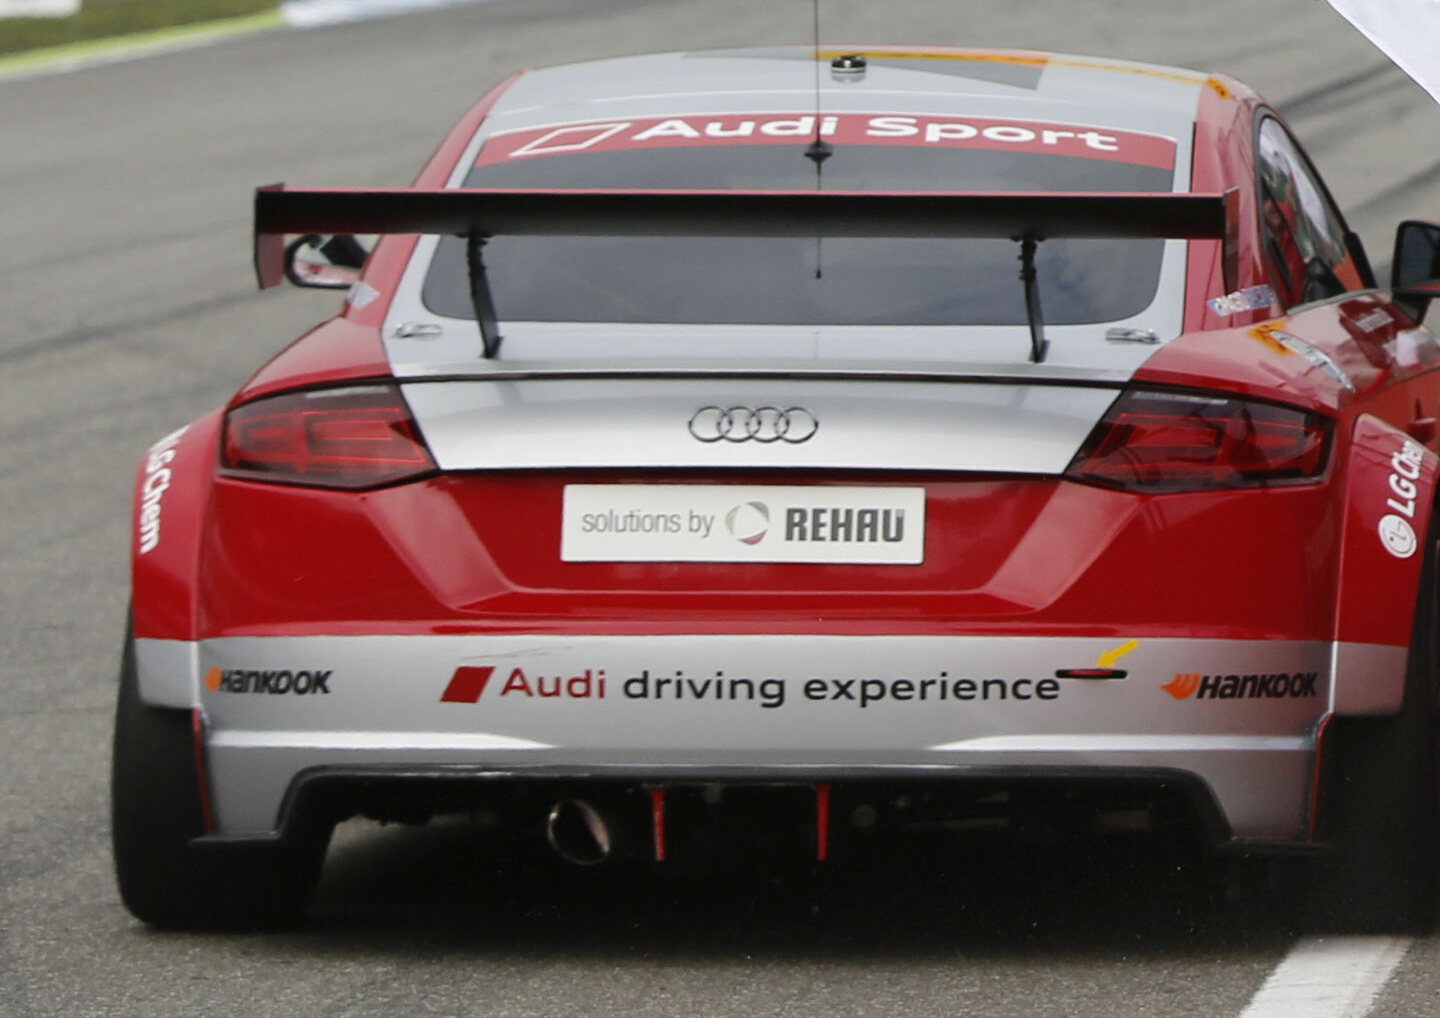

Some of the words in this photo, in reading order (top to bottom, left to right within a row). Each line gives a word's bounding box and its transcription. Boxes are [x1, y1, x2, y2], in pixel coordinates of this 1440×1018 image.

[631, 116, 839, 139] Audi
[865, 116, 1119, 151] Sport
[581, 509, 681, 533] solutions
[689, 510, 714, 538] by
[785, 508, 905, 542] REHAU
[500, 667, 606, 699] Audi
[623, 669, 785, 709] driving
[803, 671, 1060, 709] experience
